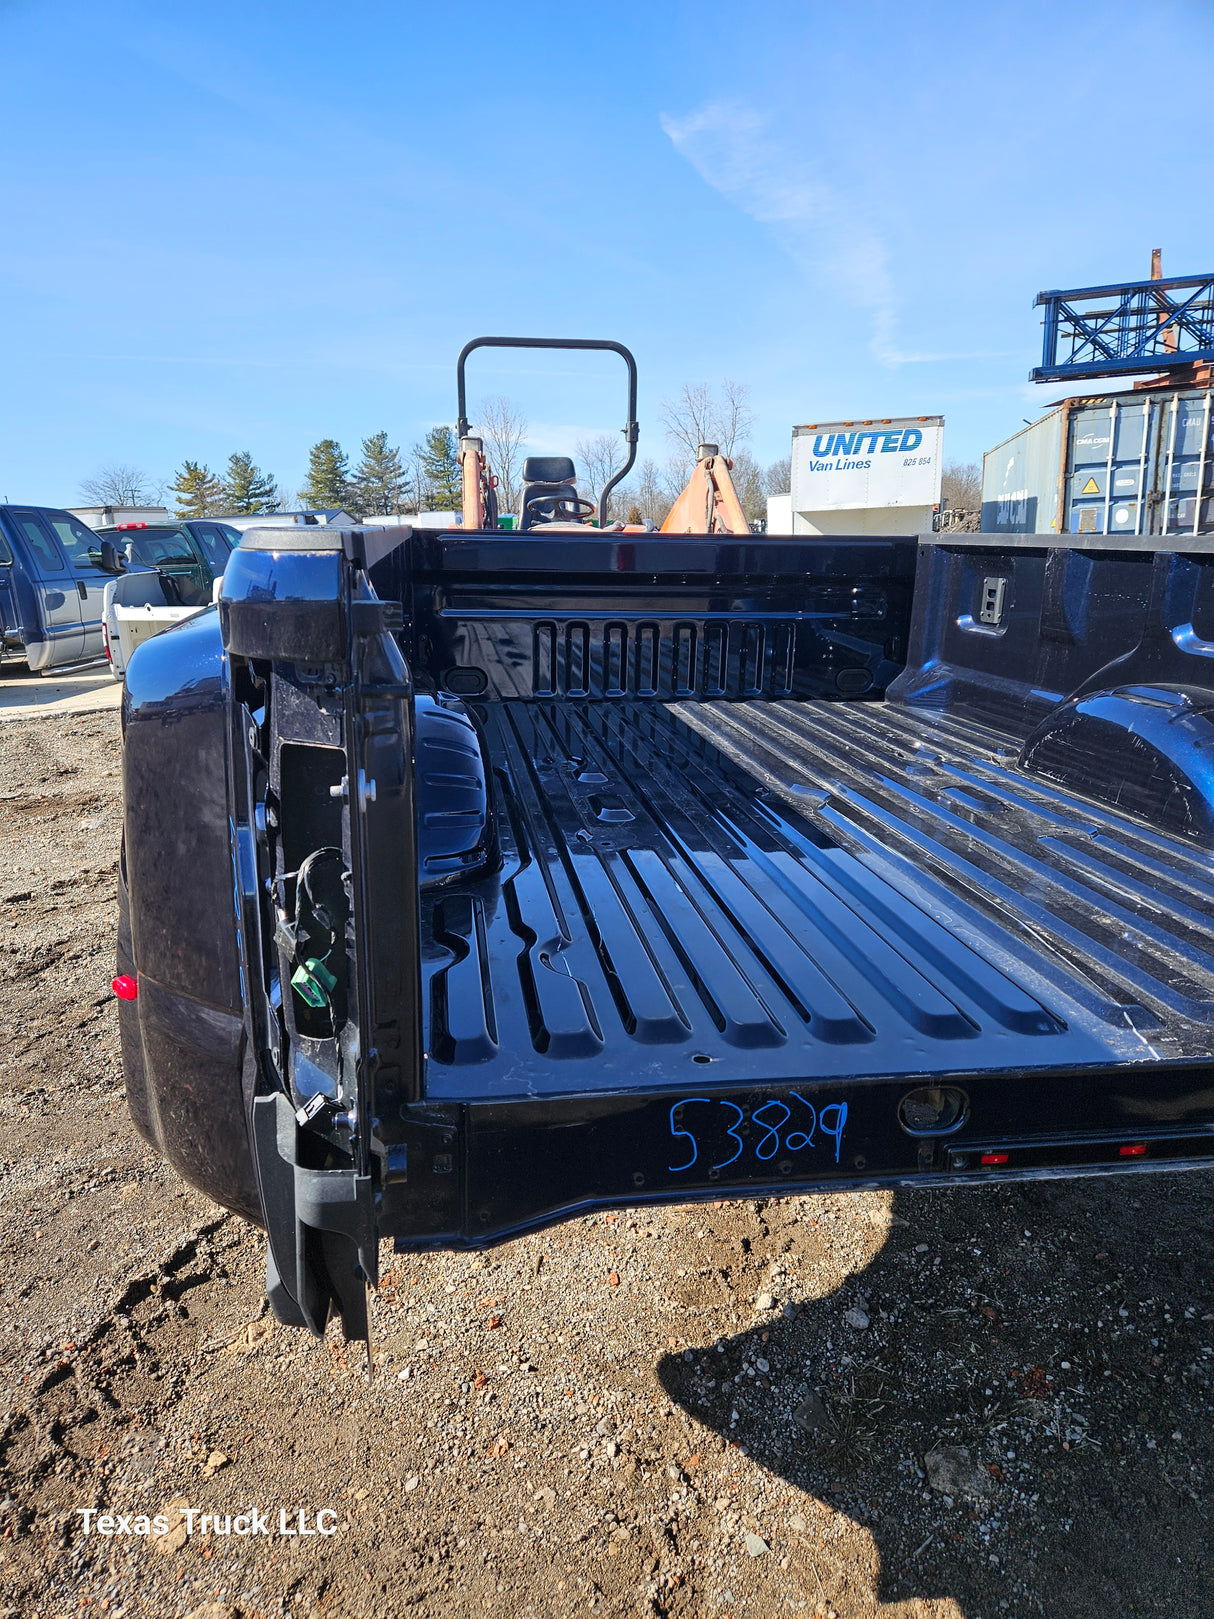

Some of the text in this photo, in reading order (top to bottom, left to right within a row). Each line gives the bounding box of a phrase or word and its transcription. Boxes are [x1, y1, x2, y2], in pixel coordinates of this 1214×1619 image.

[813, 429, 922, 457] UNITED
[809, 458, 872, 472] Van Lines
[668, 1091, 848, 1171] 53829
